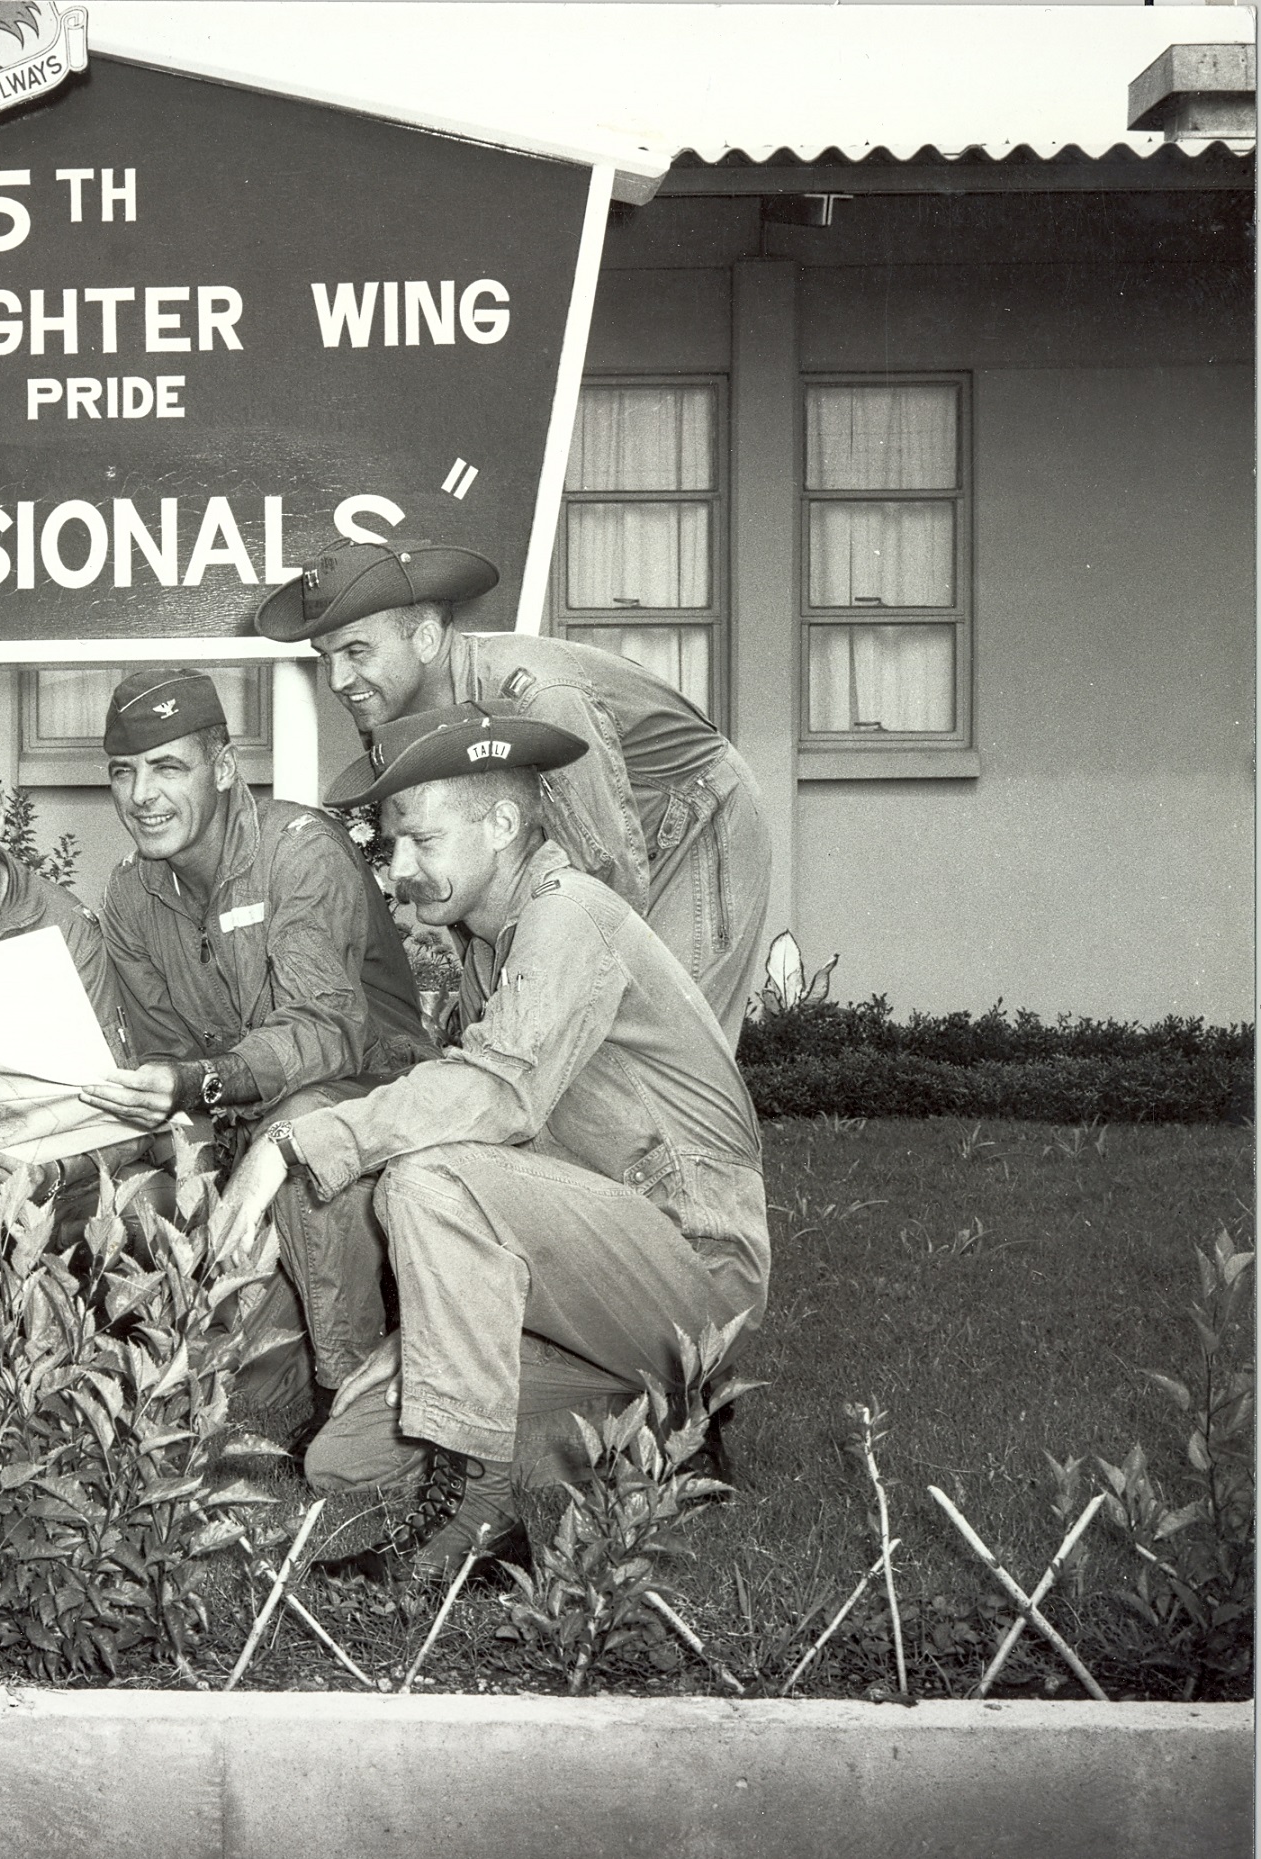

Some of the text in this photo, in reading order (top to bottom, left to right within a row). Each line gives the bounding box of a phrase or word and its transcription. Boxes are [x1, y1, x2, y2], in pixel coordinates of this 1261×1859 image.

[311, 279, 510, 348] WING
[27, 376, 185, 420] PRIDE
[472, 744, 506, 757] TALI
